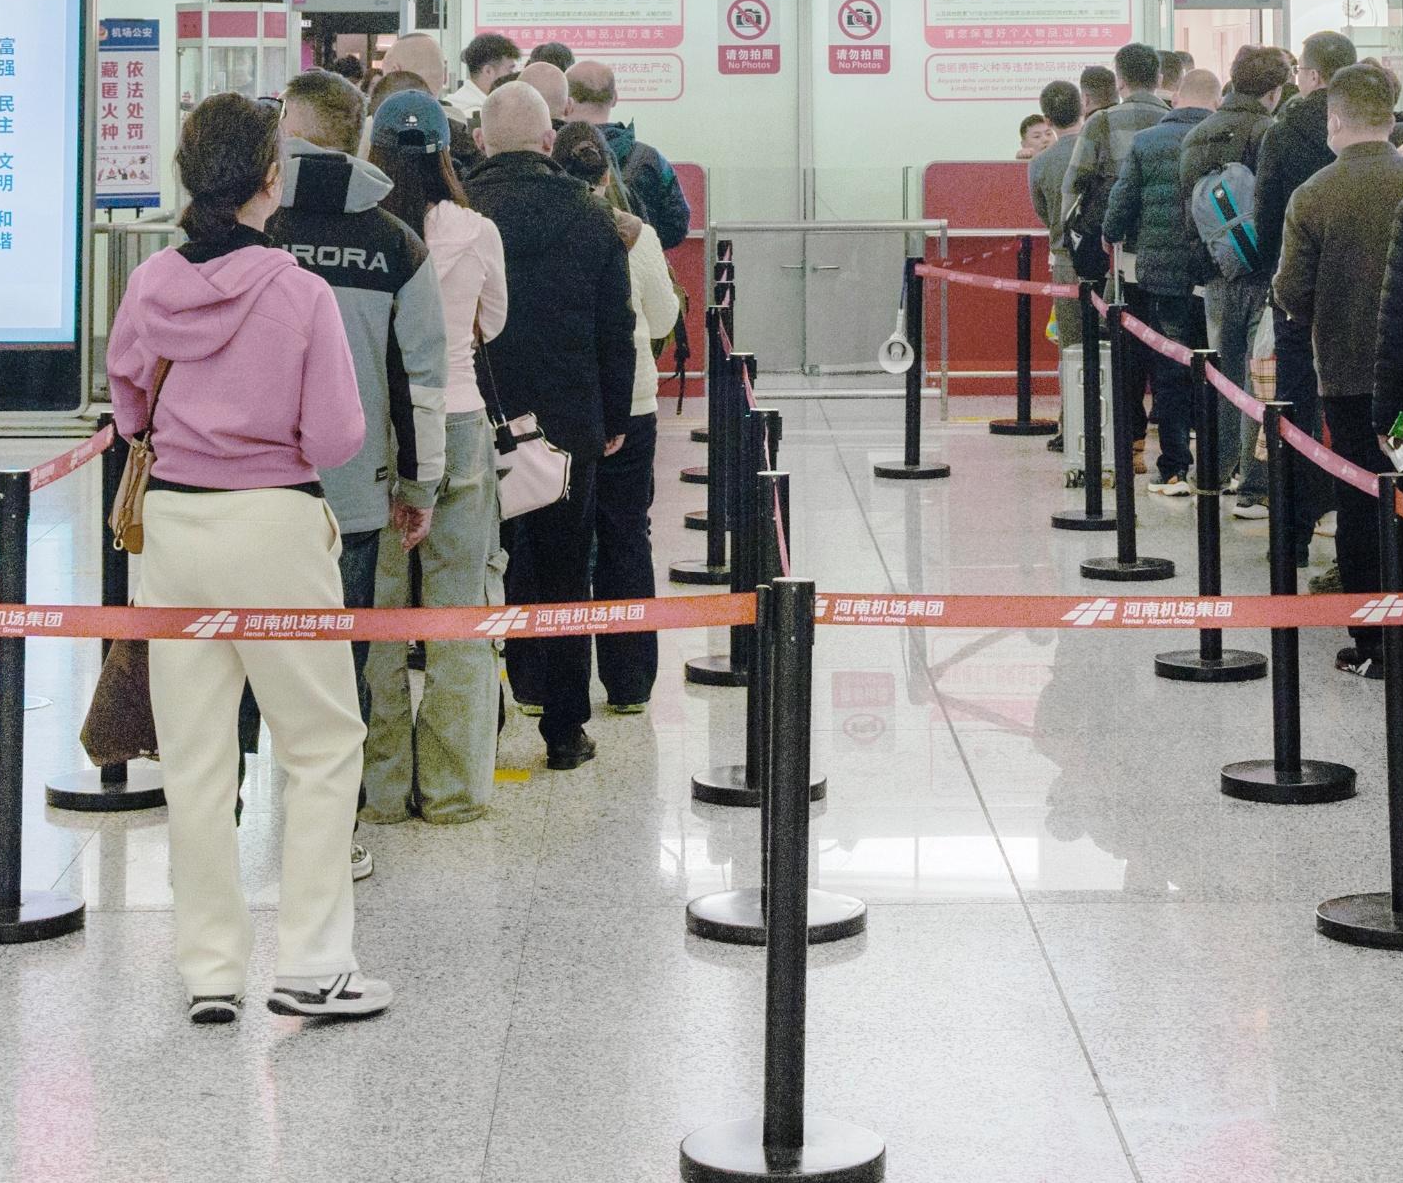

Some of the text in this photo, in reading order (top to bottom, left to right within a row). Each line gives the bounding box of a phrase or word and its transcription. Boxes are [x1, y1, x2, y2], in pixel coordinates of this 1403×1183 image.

[111, 27, 153, 38] 机场公安
[725, 49, 774, 60] 请勿拍照
[836, 49, 884, 60] 请勿拍照
[728, 61, 771, 69] No Photos
[839, 61, 881, 69] No Photos
[101, 61, 119, 141] 藏匿火种
[126, 61, 144, 141] 依法处罚
[282, 244, 389, 273] RORA
[535, 604, 645, 625] 河南机场集团
[834, 599, 944, 616] 河南机场集团
[1123, 601, 1233, 618] 河南机场集团
[244, 615, 355, 630] 河南机场集团
